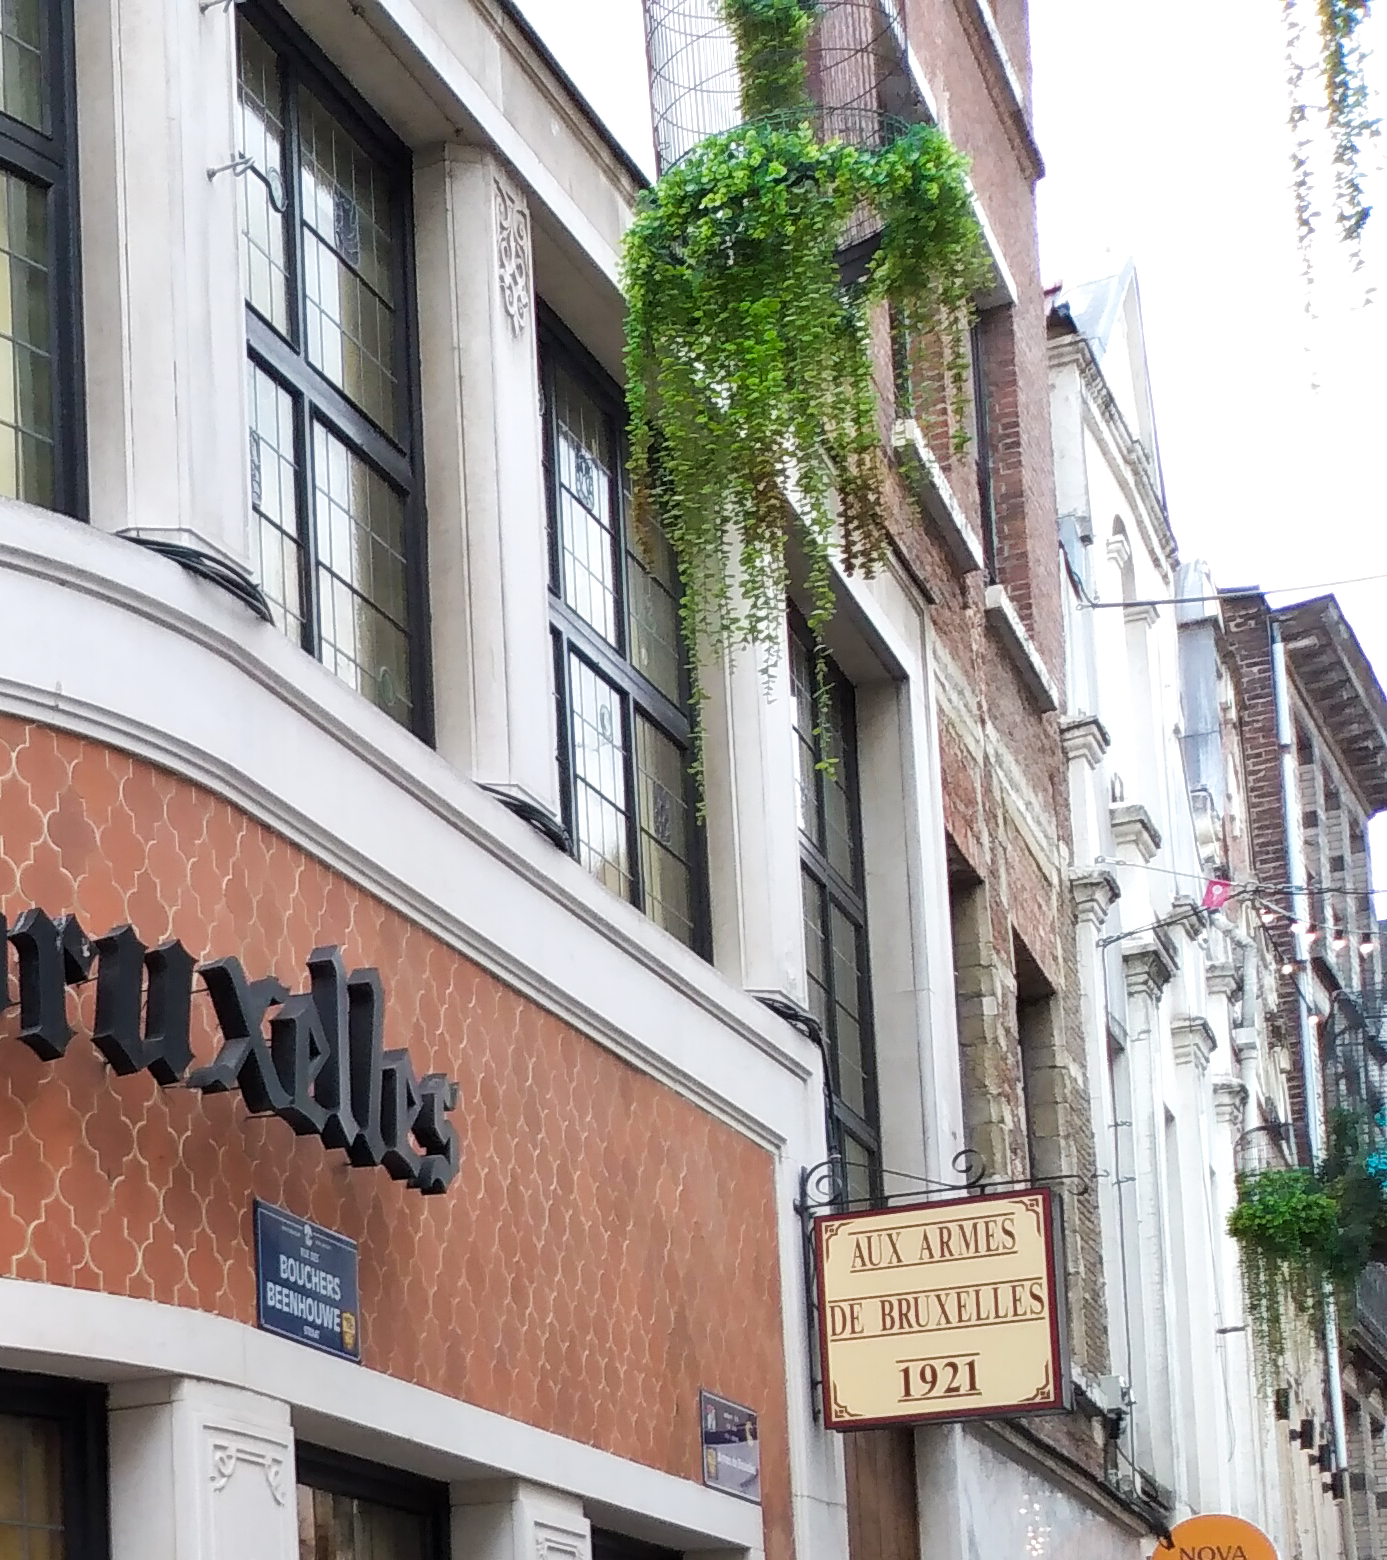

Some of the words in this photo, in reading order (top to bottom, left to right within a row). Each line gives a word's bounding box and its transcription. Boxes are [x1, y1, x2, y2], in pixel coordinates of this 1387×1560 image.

[851, 1231, 904, 1269] AUX
[918, 1217, 1017, 1261] ARMES
[279, 1254, 341, 1301] BOUCHERS
[266, 1281, 341, 1332] BEENHOUWE
[829, 1302, 865, 1337] DE
[880, 1281, 1045, 1332] BRUXELLES
[899, 1358, 981, 1397] 1921
